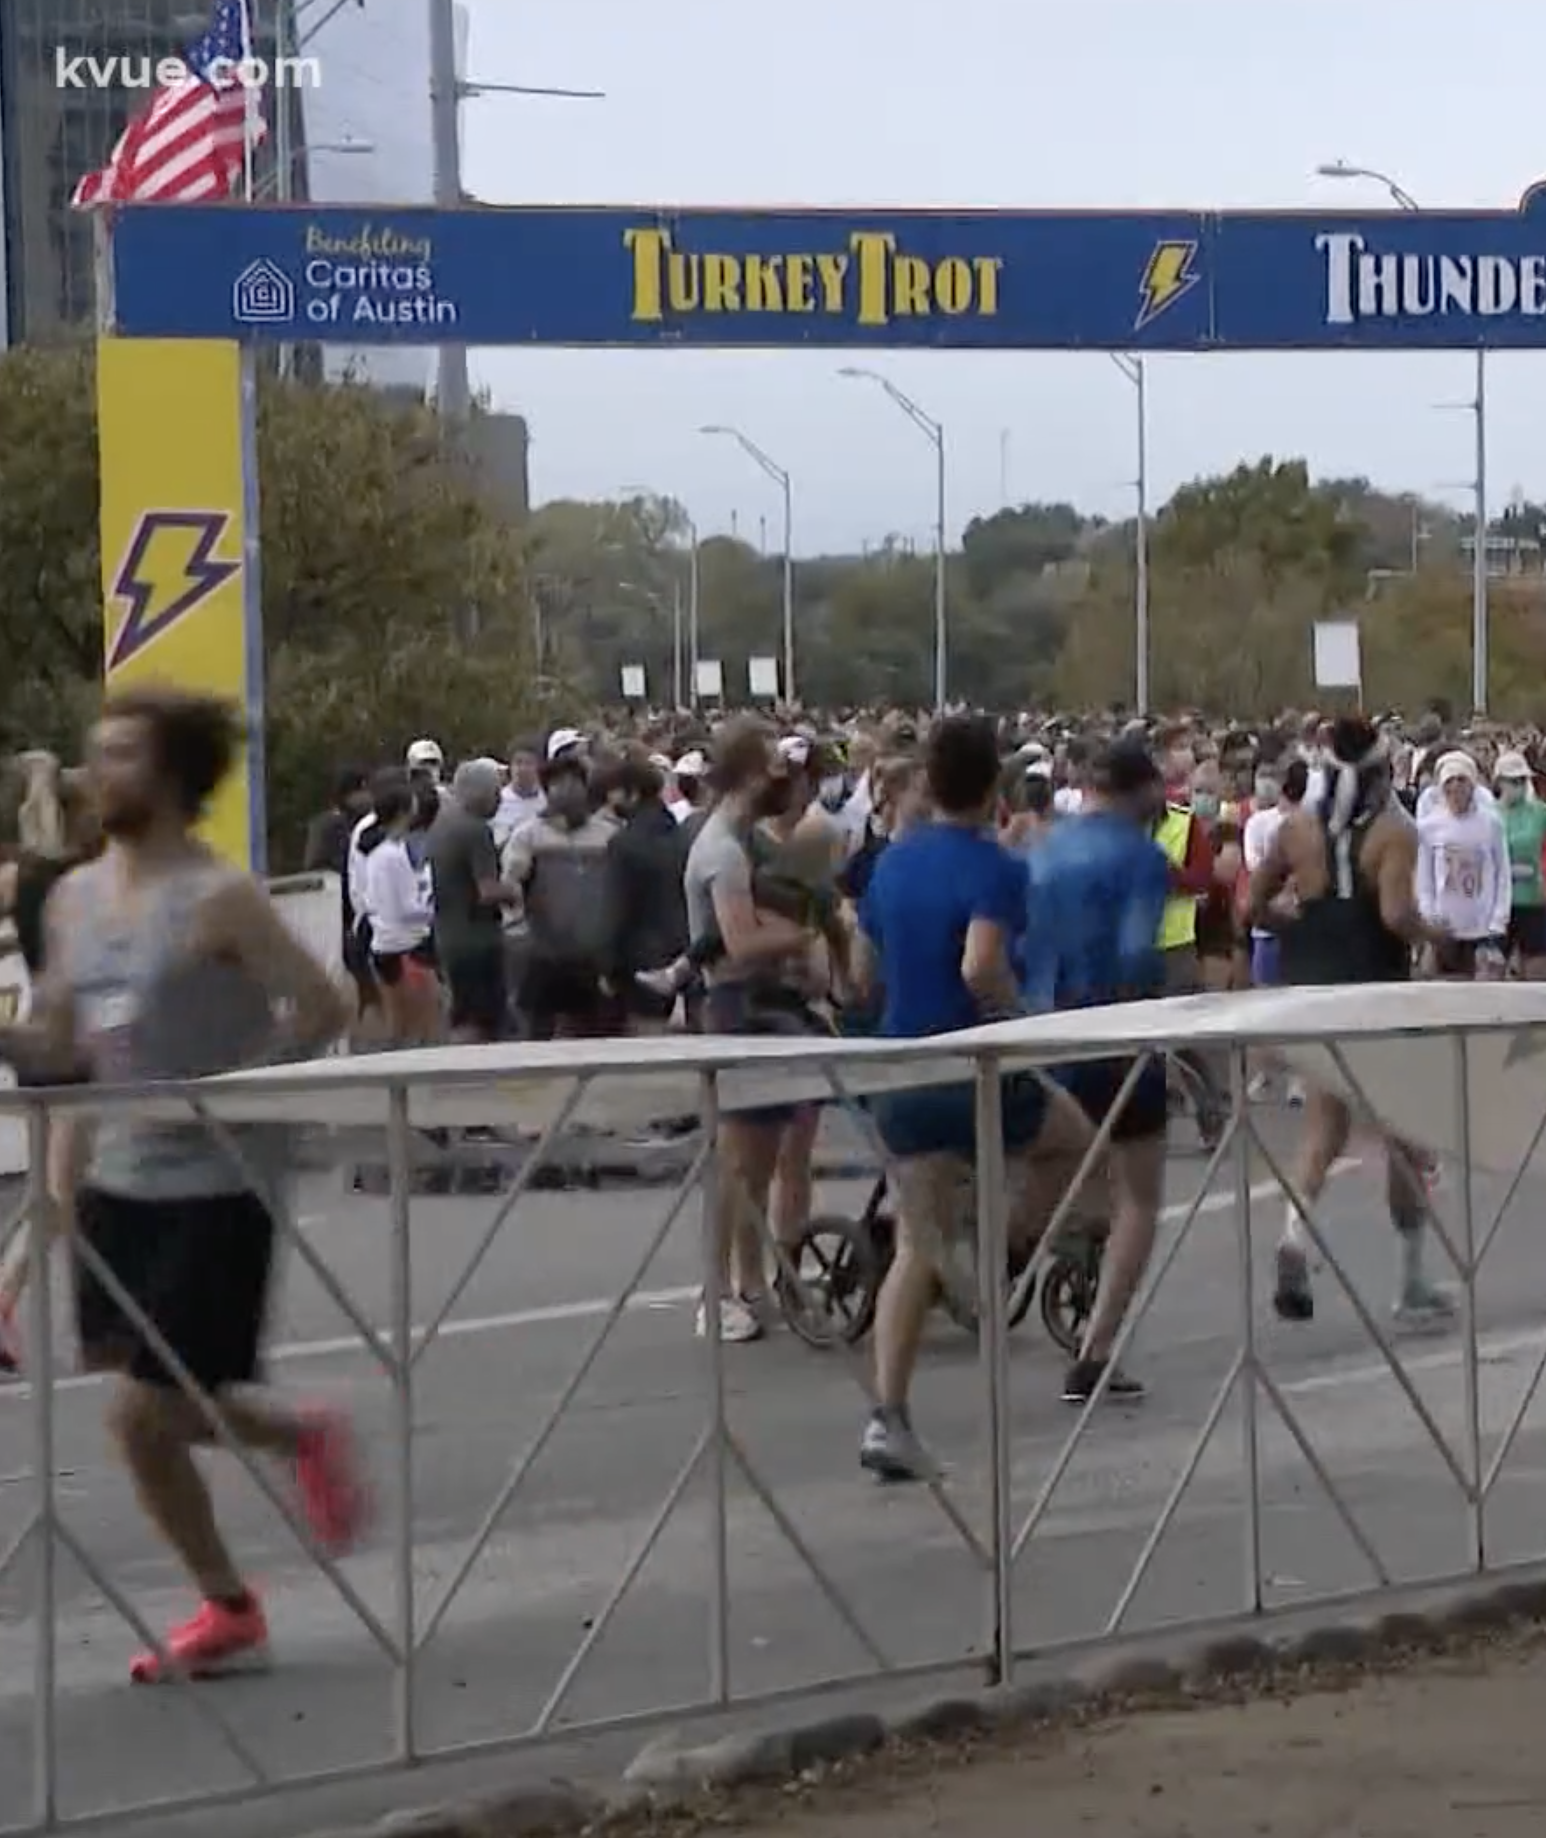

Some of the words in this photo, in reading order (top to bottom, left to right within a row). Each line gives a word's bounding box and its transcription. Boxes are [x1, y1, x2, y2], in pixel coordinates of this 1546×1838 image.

[305, 259, 432, 290] Caritas
[306, 293, 341, 323] of
[353, 295, 457, 322] Austin
